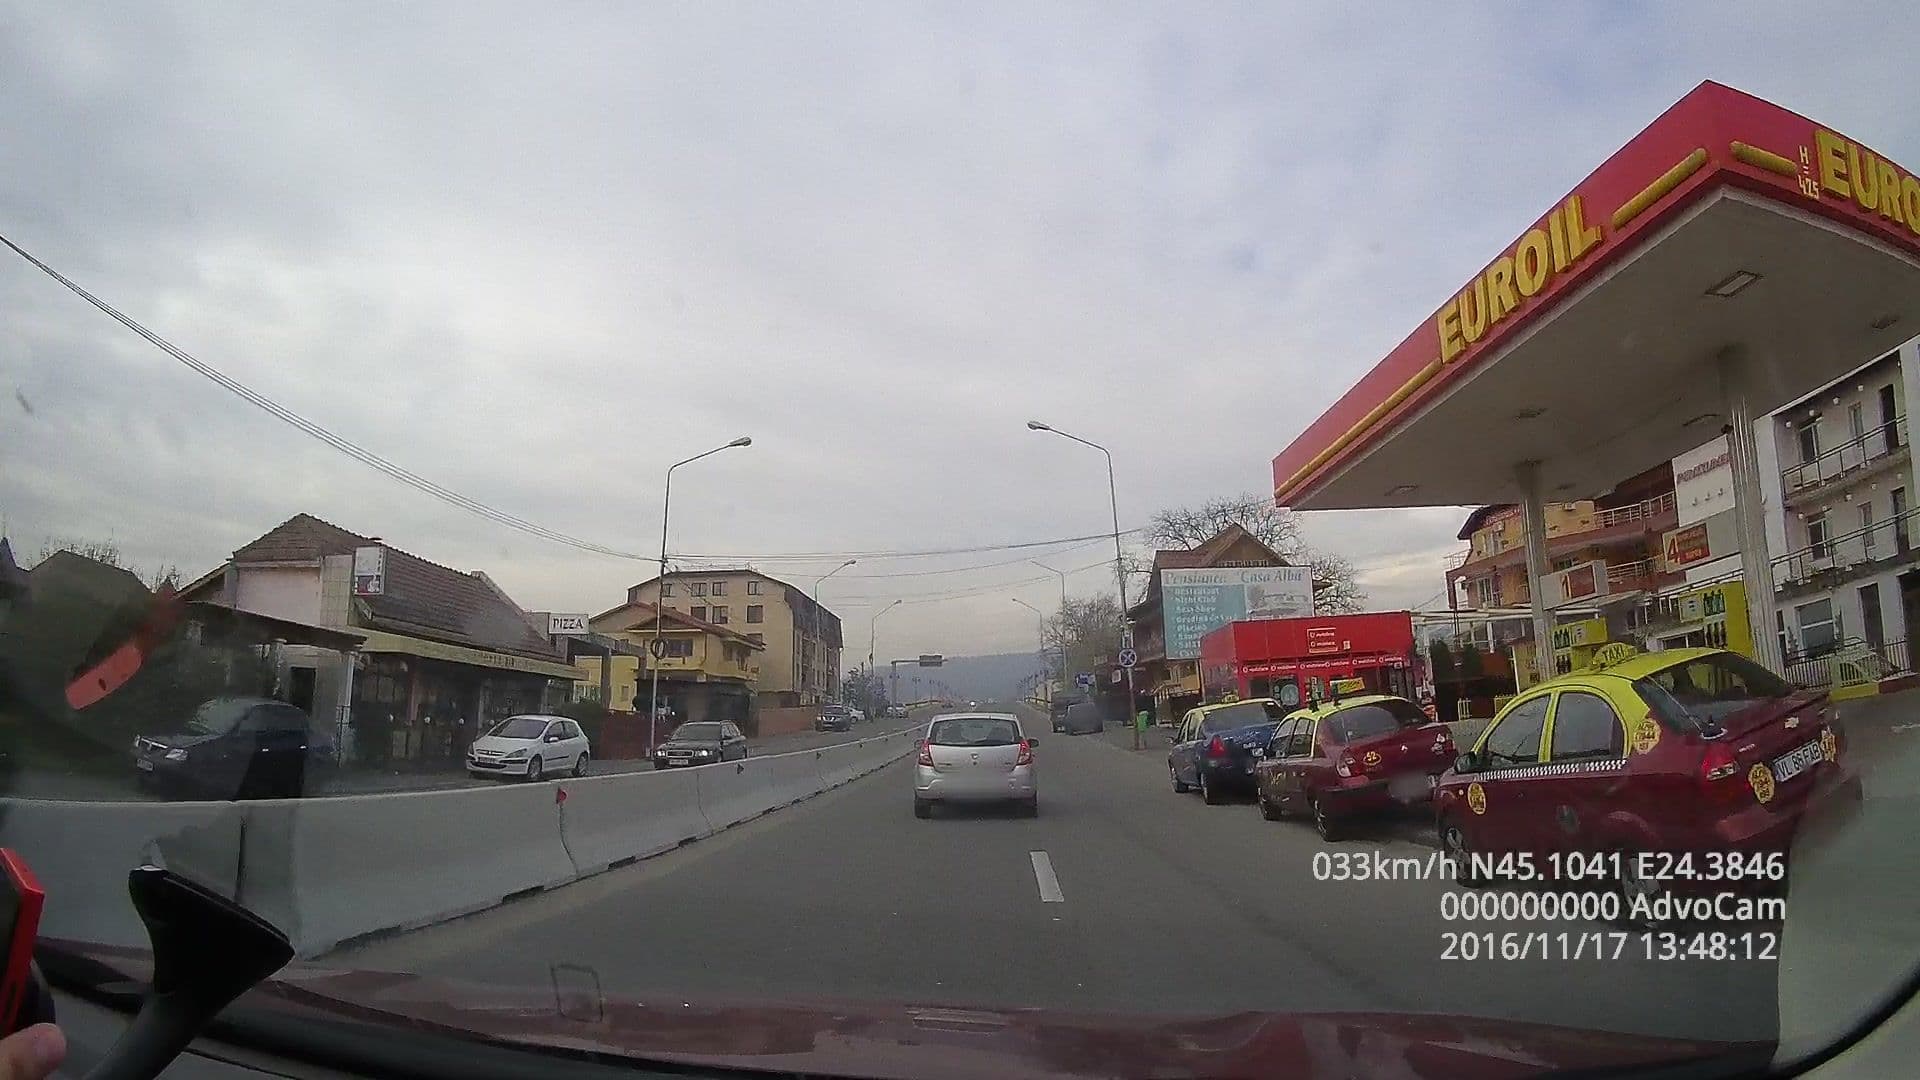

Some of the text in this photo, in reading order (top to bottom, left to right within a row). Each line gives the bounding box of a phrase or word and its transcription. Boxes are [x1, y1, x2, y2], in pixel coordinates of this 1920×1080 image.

[1799, 144, 1809, 165] H
[1437, 195, 1604, 364] EUROIL
[553, 618, 583, 630] PIZZA
[1602, 644, 1625, 662] TAXI
